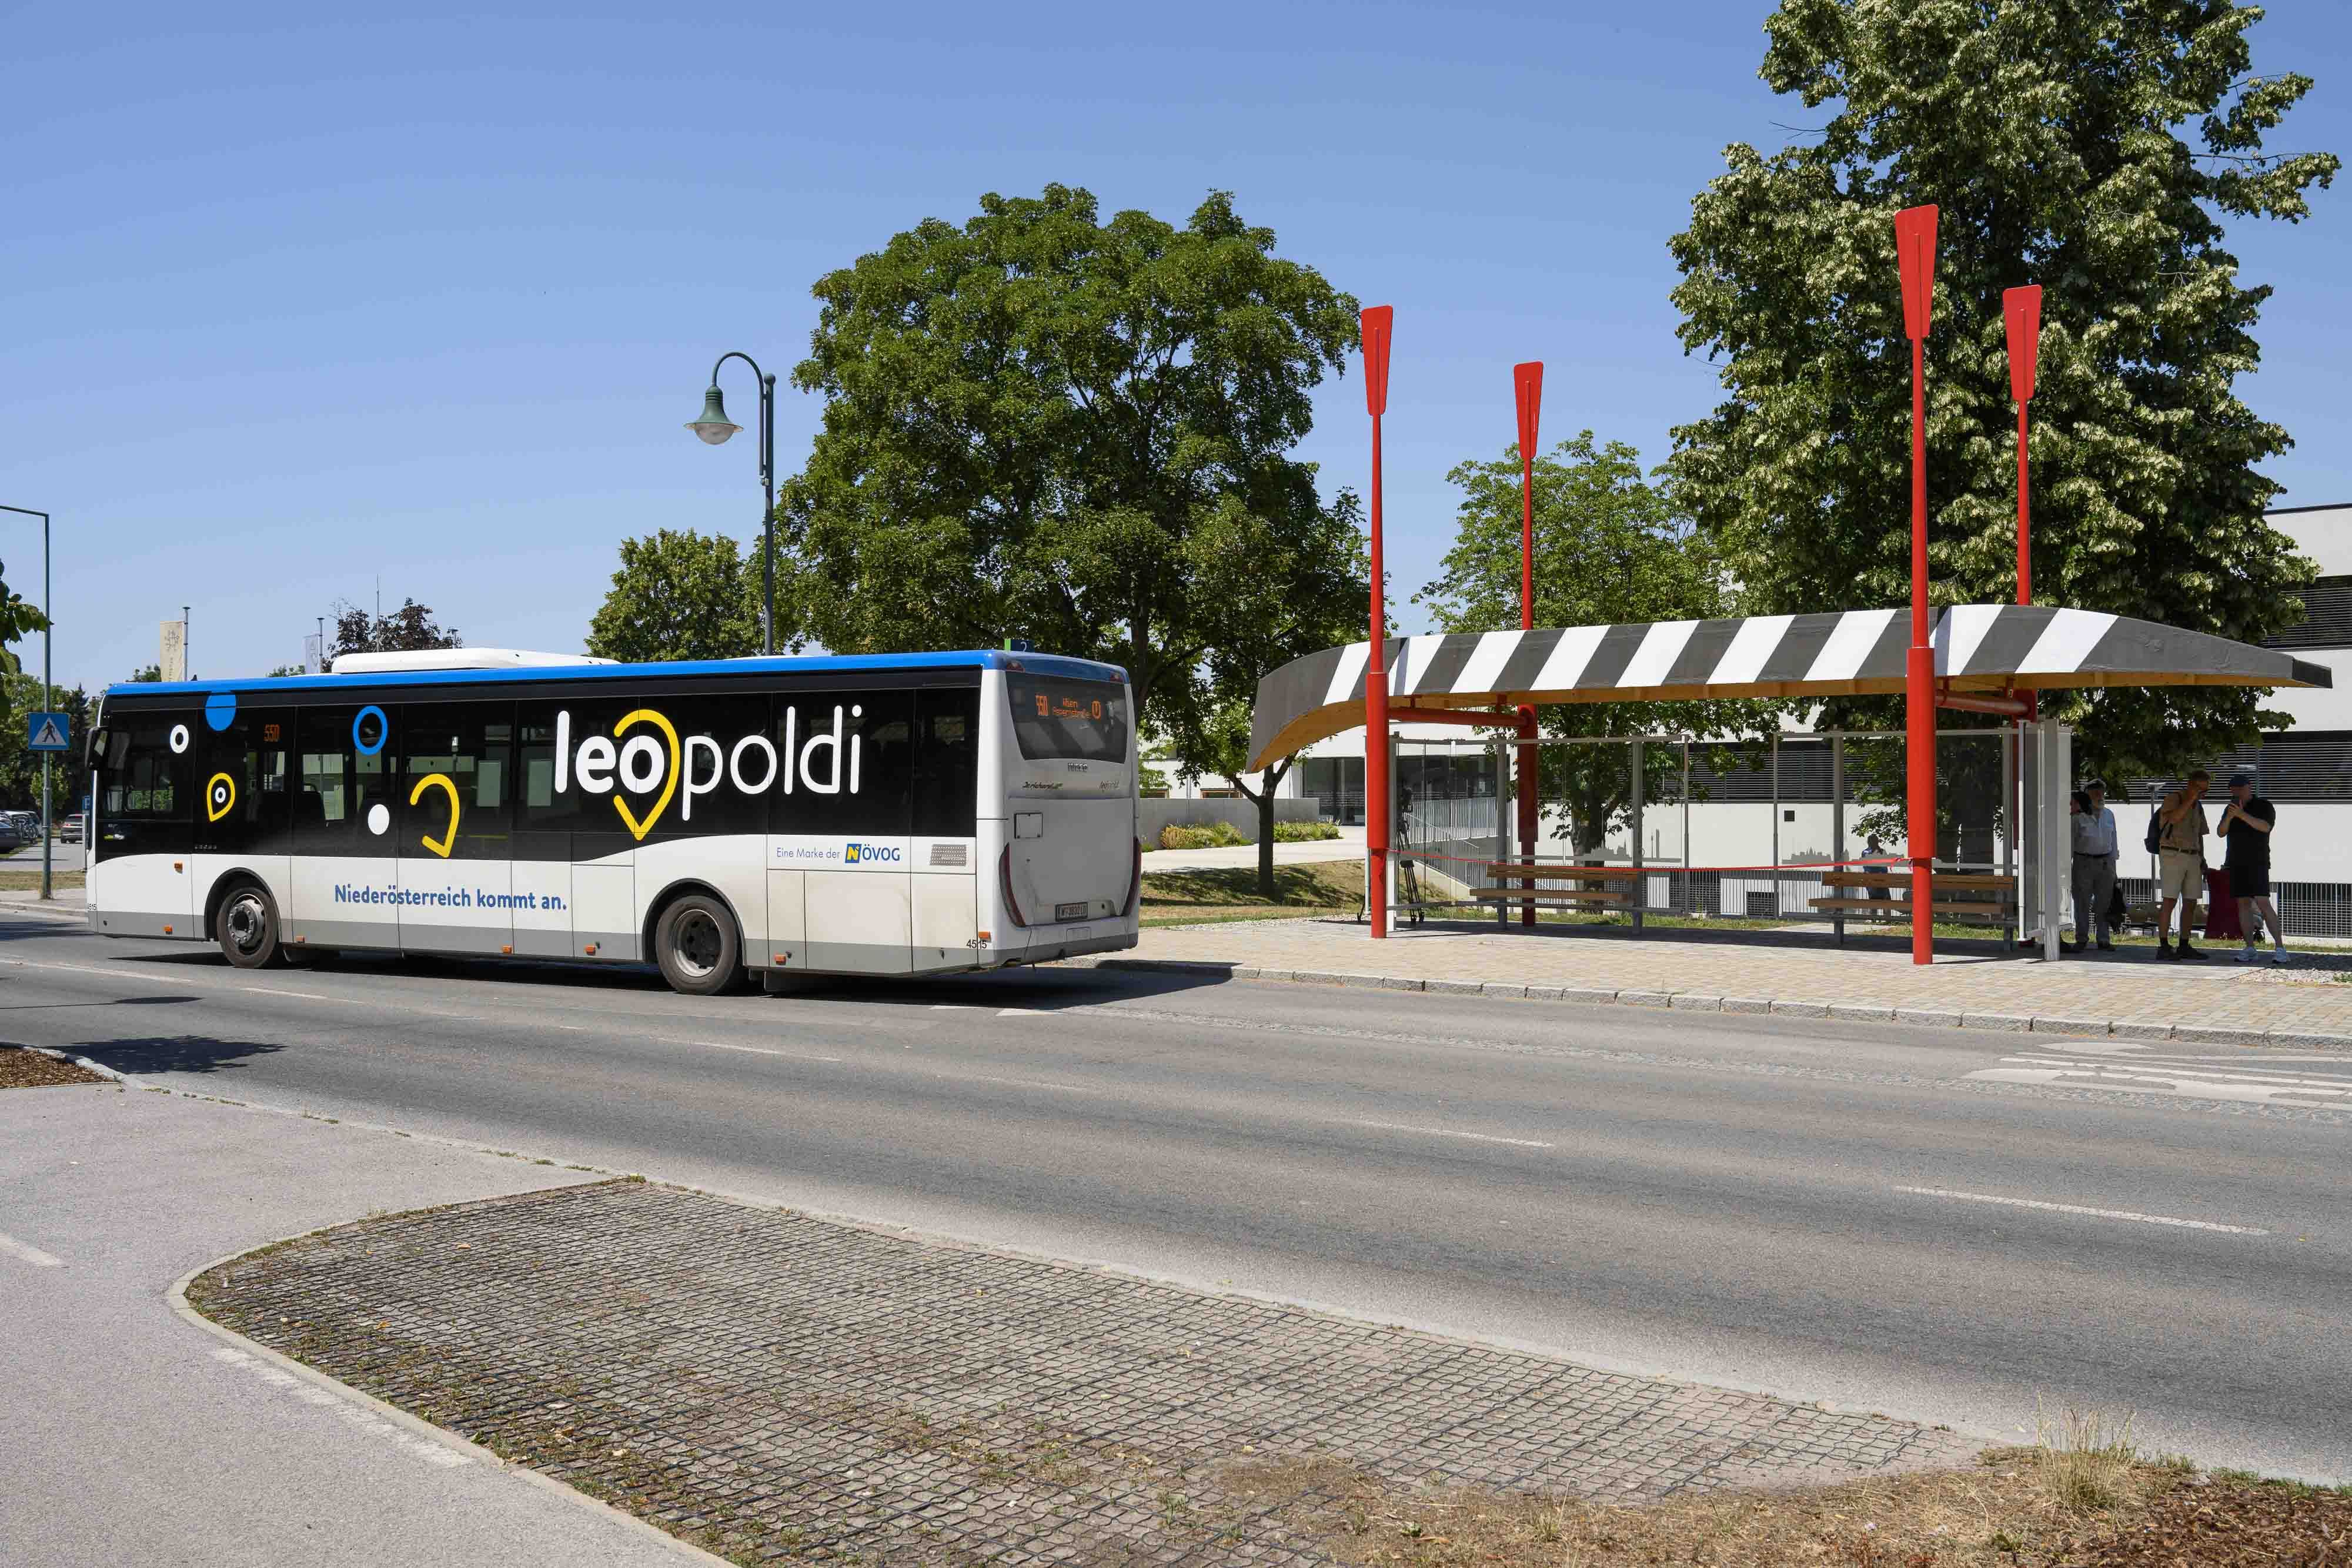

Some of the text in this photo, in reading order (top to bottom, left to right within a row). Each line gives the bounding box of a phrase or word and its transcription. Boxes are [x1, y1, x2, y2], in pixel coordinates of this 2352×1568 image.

[554, 705, 862, 821] leopoldi
[777, 848, 794, 857] Eine
[797, 848, 823, 858] Marke
[826, 847, 840, 859] der
[335, 884, 567, 910] Niederösterreich kommt an.
[966, 939, 987, 949] 4515
